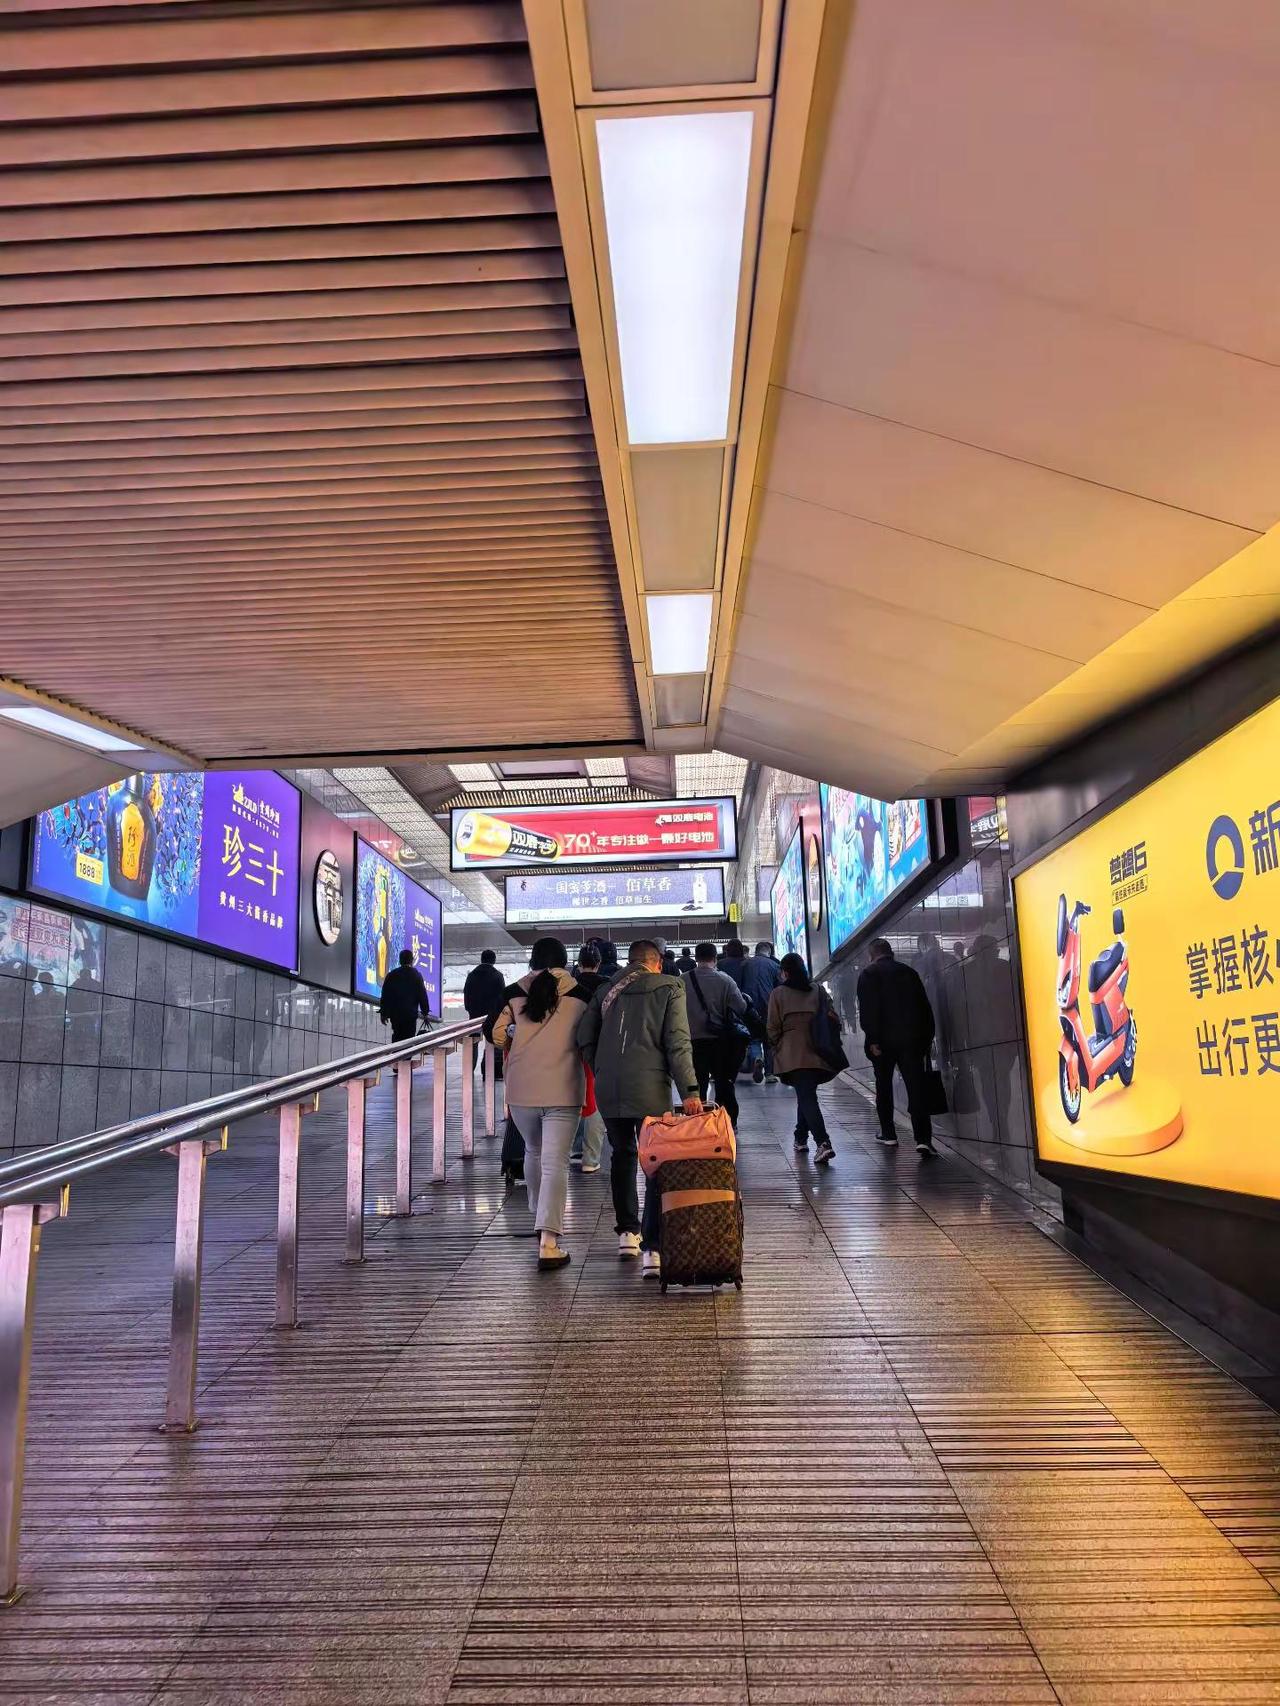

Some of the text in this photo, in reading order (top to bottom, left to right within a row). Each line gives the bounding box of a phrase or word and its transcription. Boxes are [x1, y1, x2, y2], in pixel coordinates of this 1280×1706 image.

[79, 863, 95, 879] 1888
[221, 824, 284, 897] 珍三十
[1186, 924, 1280, 1000] 掌握核
[1196, 1011, 1280, 1077] 出行更
